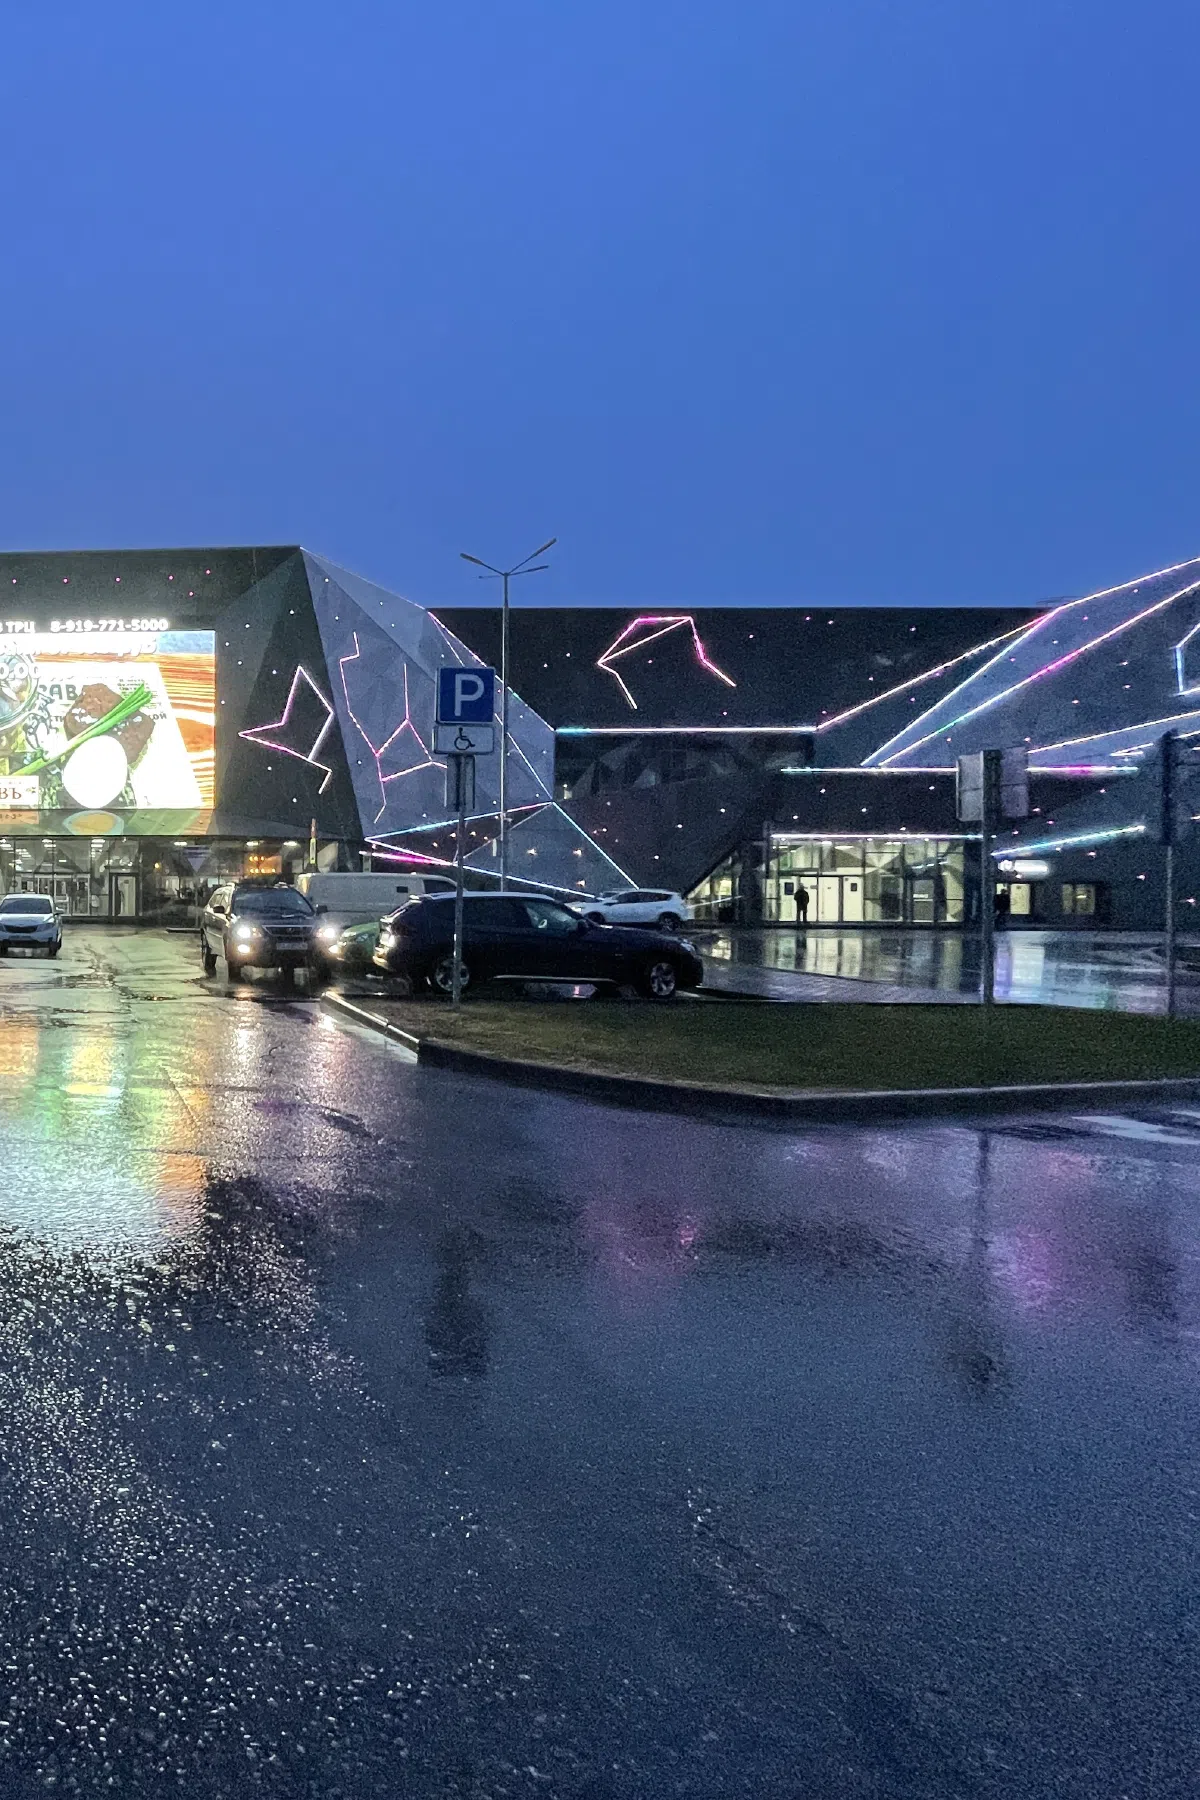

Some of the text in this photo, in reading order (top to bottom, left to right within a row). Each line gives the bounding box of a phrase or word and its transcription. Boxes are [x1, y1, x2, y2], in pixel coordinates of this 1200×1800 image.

[6, 620, 36, 634] ТРЦ
[50, 618, 169, 633] 8-919-771-5000
[454, 673, 485, 717] P
